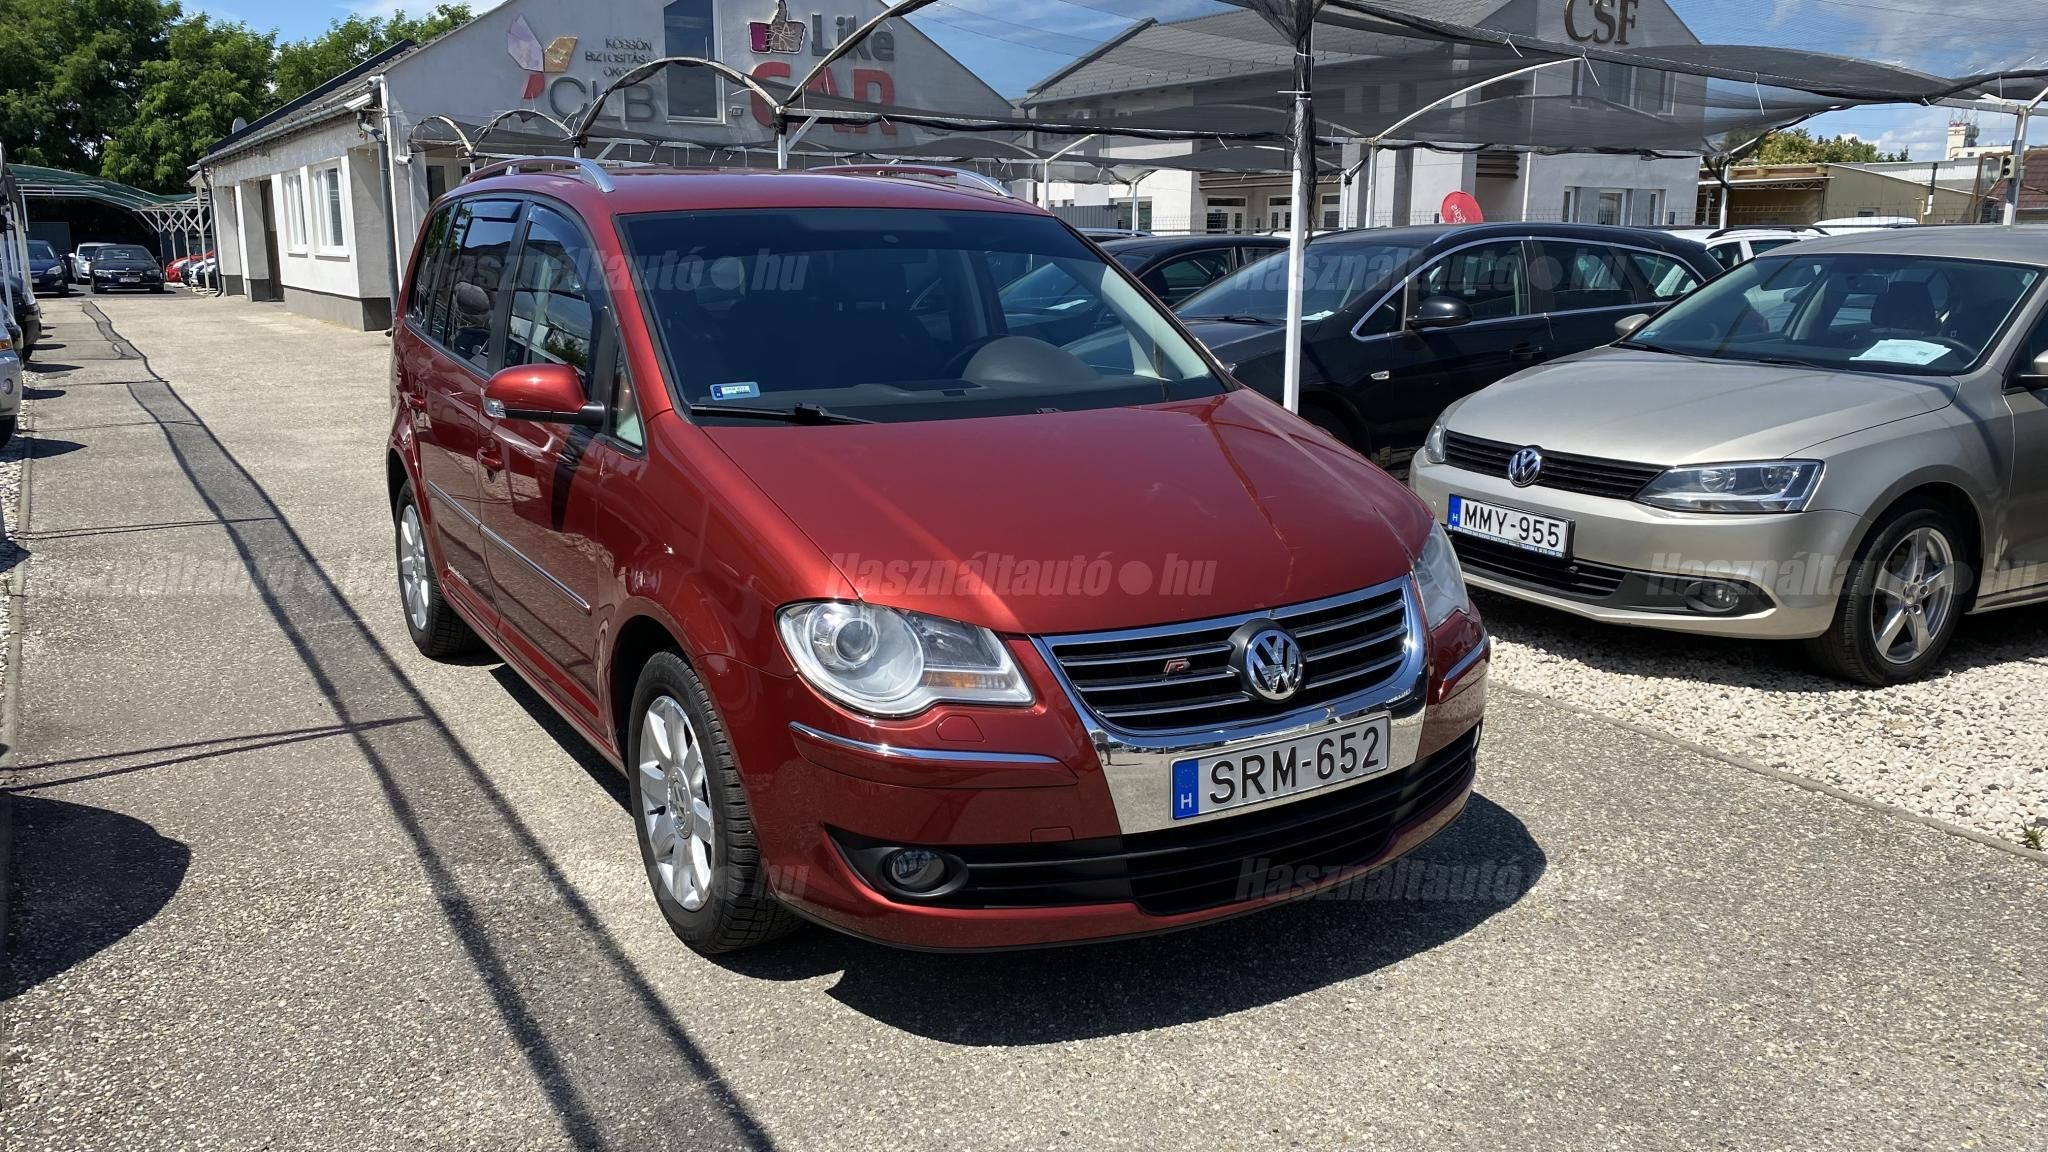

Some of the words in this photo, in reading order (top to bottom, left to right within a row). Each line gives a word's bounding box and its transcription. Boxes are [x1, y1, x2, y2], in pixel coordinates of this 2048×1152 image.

[811, 13, 895, 62] Like
[1564, 0, 1639, 45] CSF
[548, 76, 657, 122] CLB
[751, 61, 898, 136] CAR
[1452, 513, 1458, 521] H
[1464, 503, 1560, 548] MMY-955
[1180, 792, 1193, 810] H
[1209, 726, 1380, 804] SRM-652
